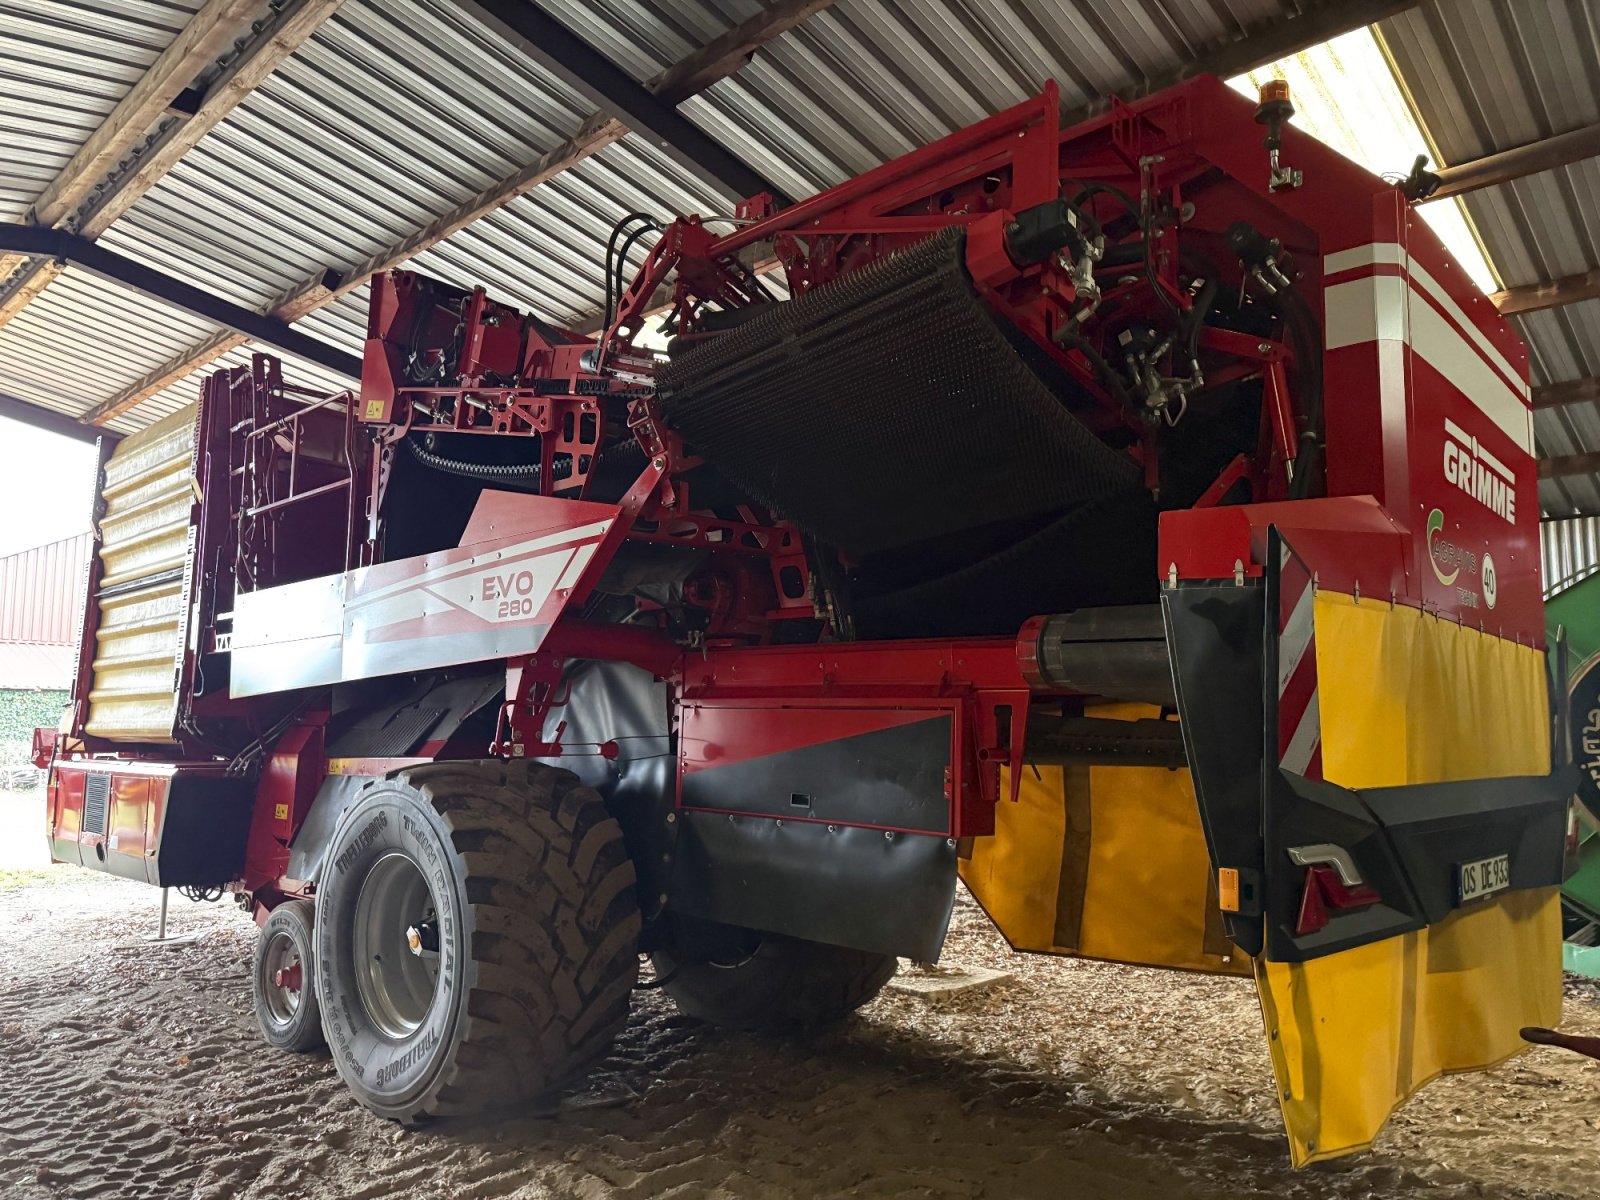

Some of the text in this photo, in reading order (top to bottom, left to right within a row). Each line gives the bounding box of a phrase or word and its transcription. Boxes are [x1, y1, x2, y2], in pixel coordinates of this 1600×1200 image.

[1443, 437, 1516, 525] GRIMME
[482, 571, 534, 601] EVO
[1484, 568, 1494, 595] 40
[498, 599, 532, 618] 280
[335, 810, 388, 875] TRELLEBORG
[1463, 866, 1476, 895] OS
[1481, 861, 1493, 890] DE
[434, 869, 455, 995] RADIAL
[376, 1027, 439, 1088] TRELLEBORG
